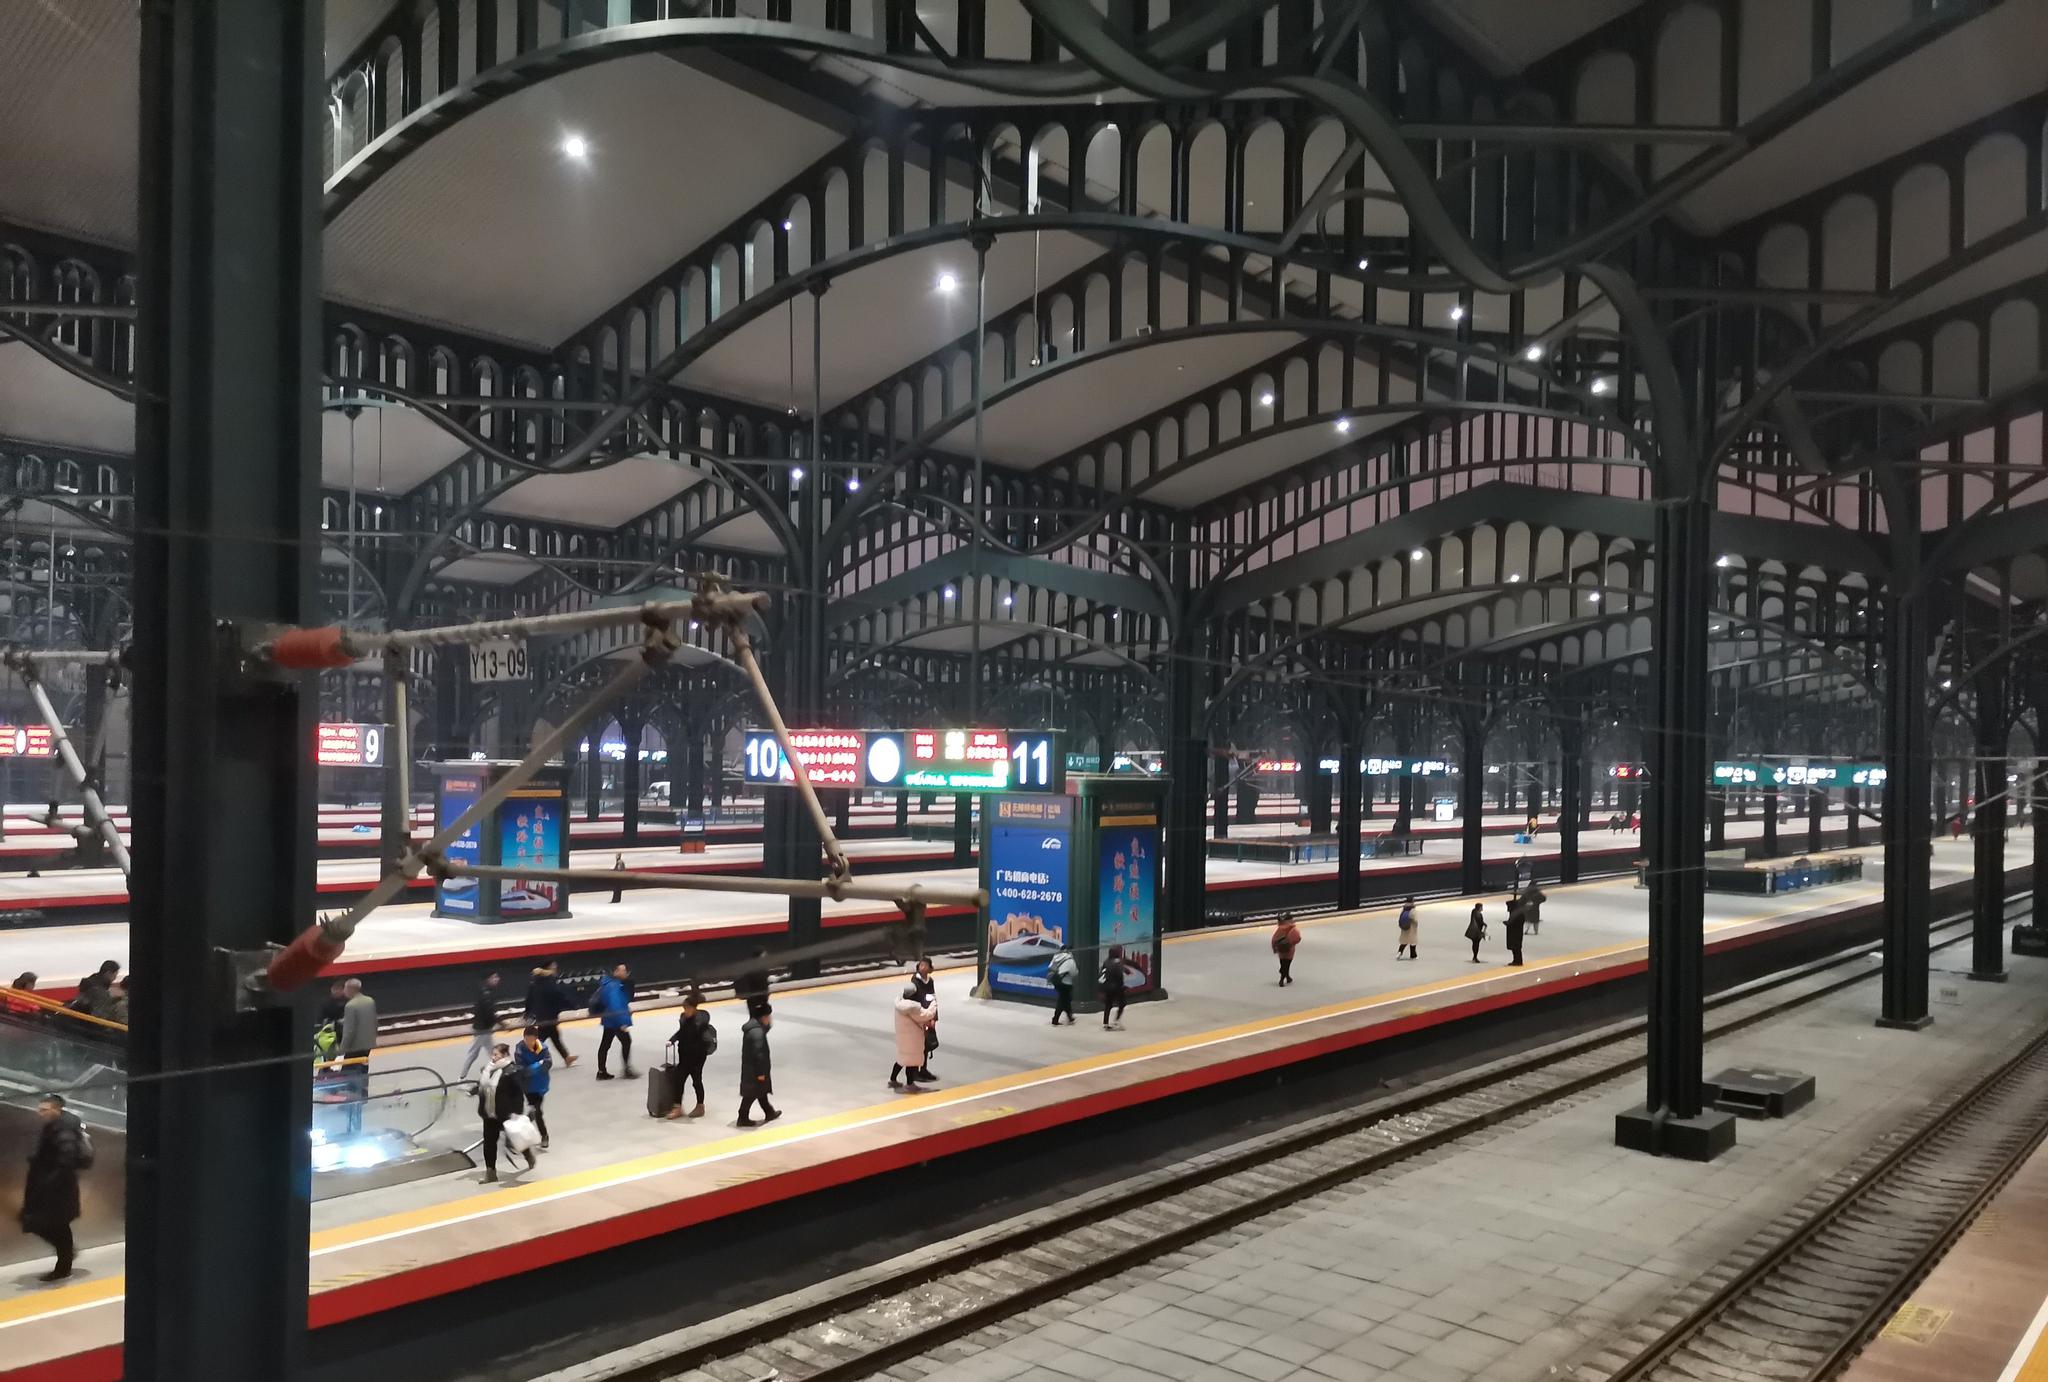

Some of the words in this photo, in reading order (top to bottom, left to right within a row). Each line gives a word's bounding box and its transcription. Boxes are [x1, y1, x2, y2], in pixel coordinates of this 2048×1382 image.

[472, 648, 525, 679] Y13-09
[366, 729, 379, 763] 9
[746, 738, 778, 777] 10
[1013, 740, 1047, 785] 11
